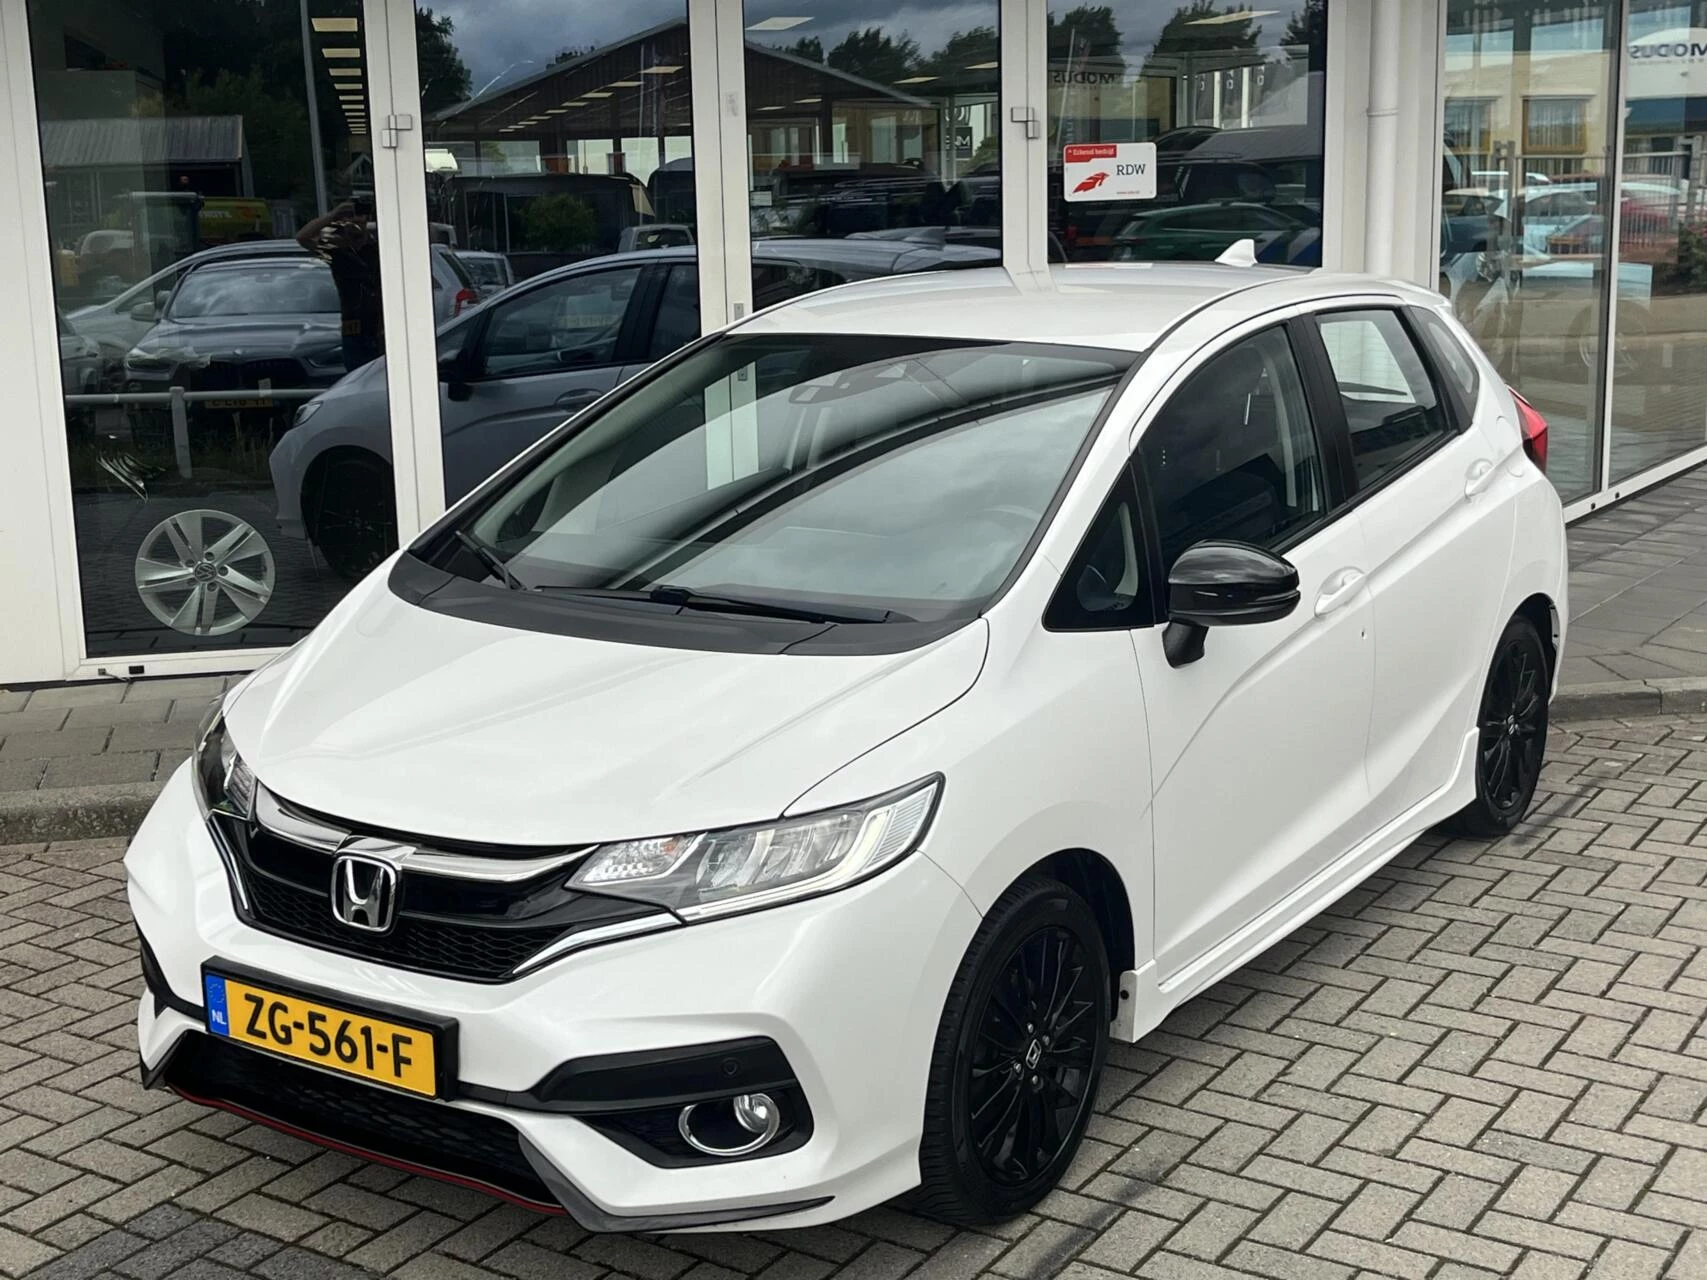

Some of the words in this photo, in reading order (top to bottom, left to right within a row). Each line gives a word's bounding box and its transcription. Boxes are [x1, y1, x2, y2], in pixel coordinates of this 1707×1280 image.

[1116, 163, 1146, 176] RDW
[211, 1009, 227, 1026] NL
[244, 993, 413, 1078] ZG-561-F
